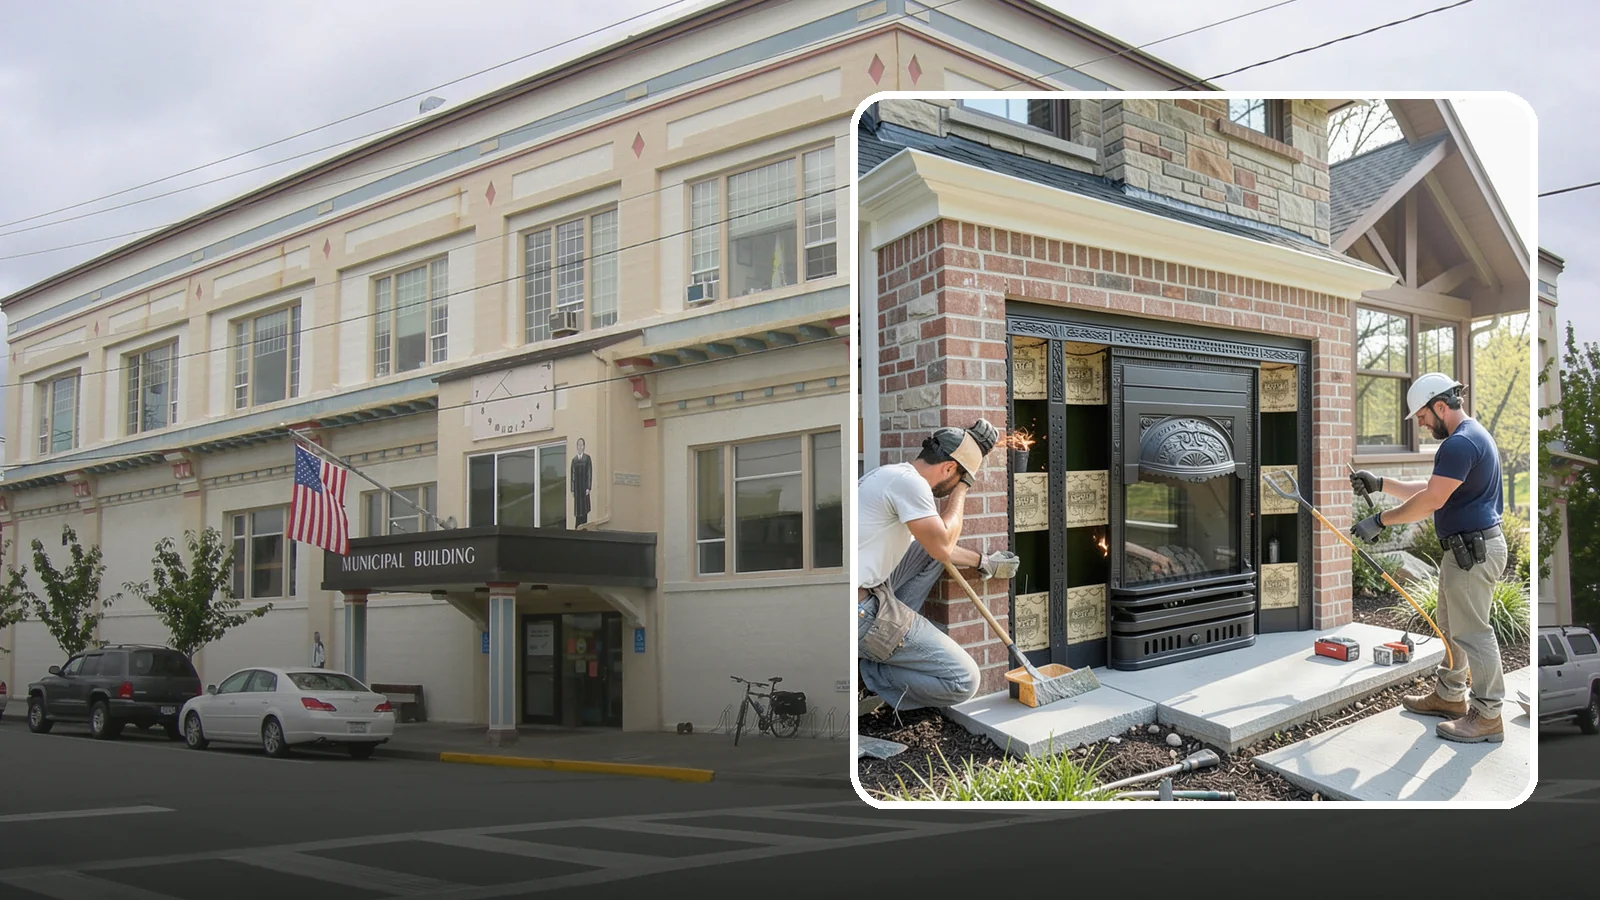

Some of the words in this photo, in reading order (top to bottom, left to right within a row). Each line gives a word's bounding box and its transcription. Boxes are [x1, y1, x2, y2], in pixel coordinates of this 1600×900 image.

[507, 425, 514, 433] 12
[342, 553, 405, 571] MUNICIPAL
[414, 546, 475, 567] BUILDING
